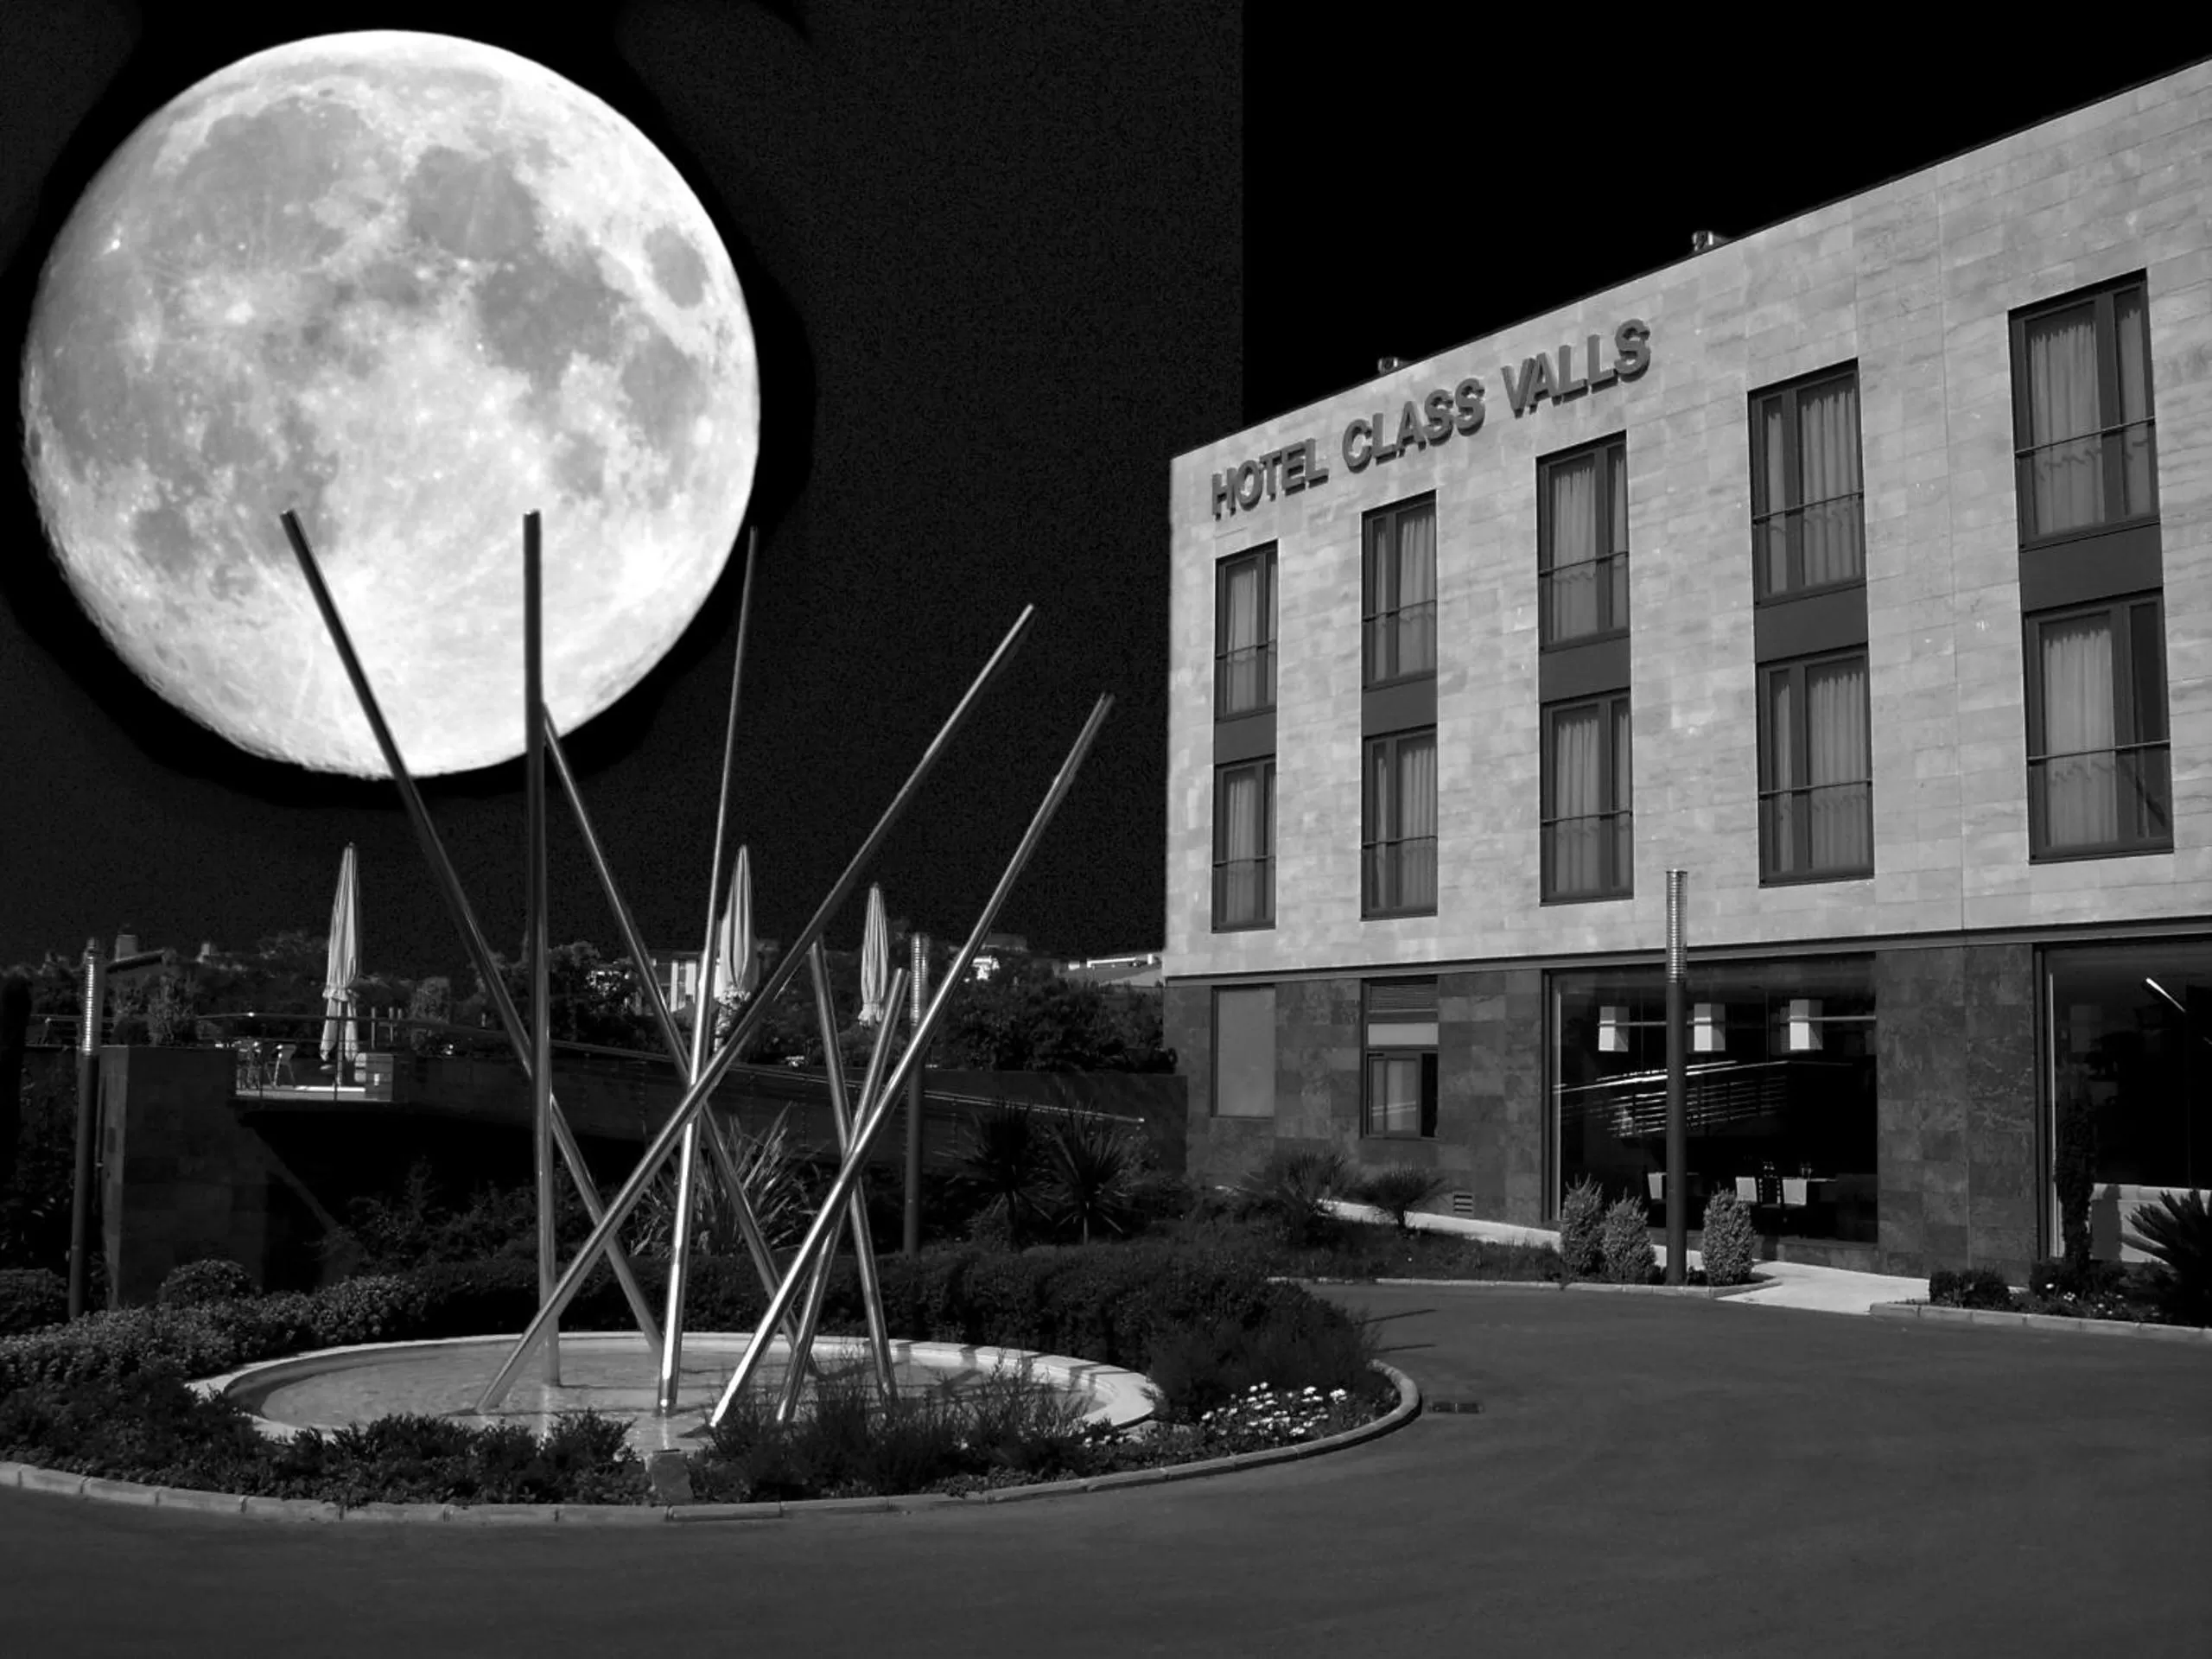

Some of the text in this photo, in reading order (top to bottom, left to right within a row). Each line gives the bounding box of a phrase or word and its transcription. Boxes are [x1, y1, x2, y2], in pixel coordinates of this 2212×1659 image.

[1212, 319, 1650, 520] HOTEL CLASS VALLS
